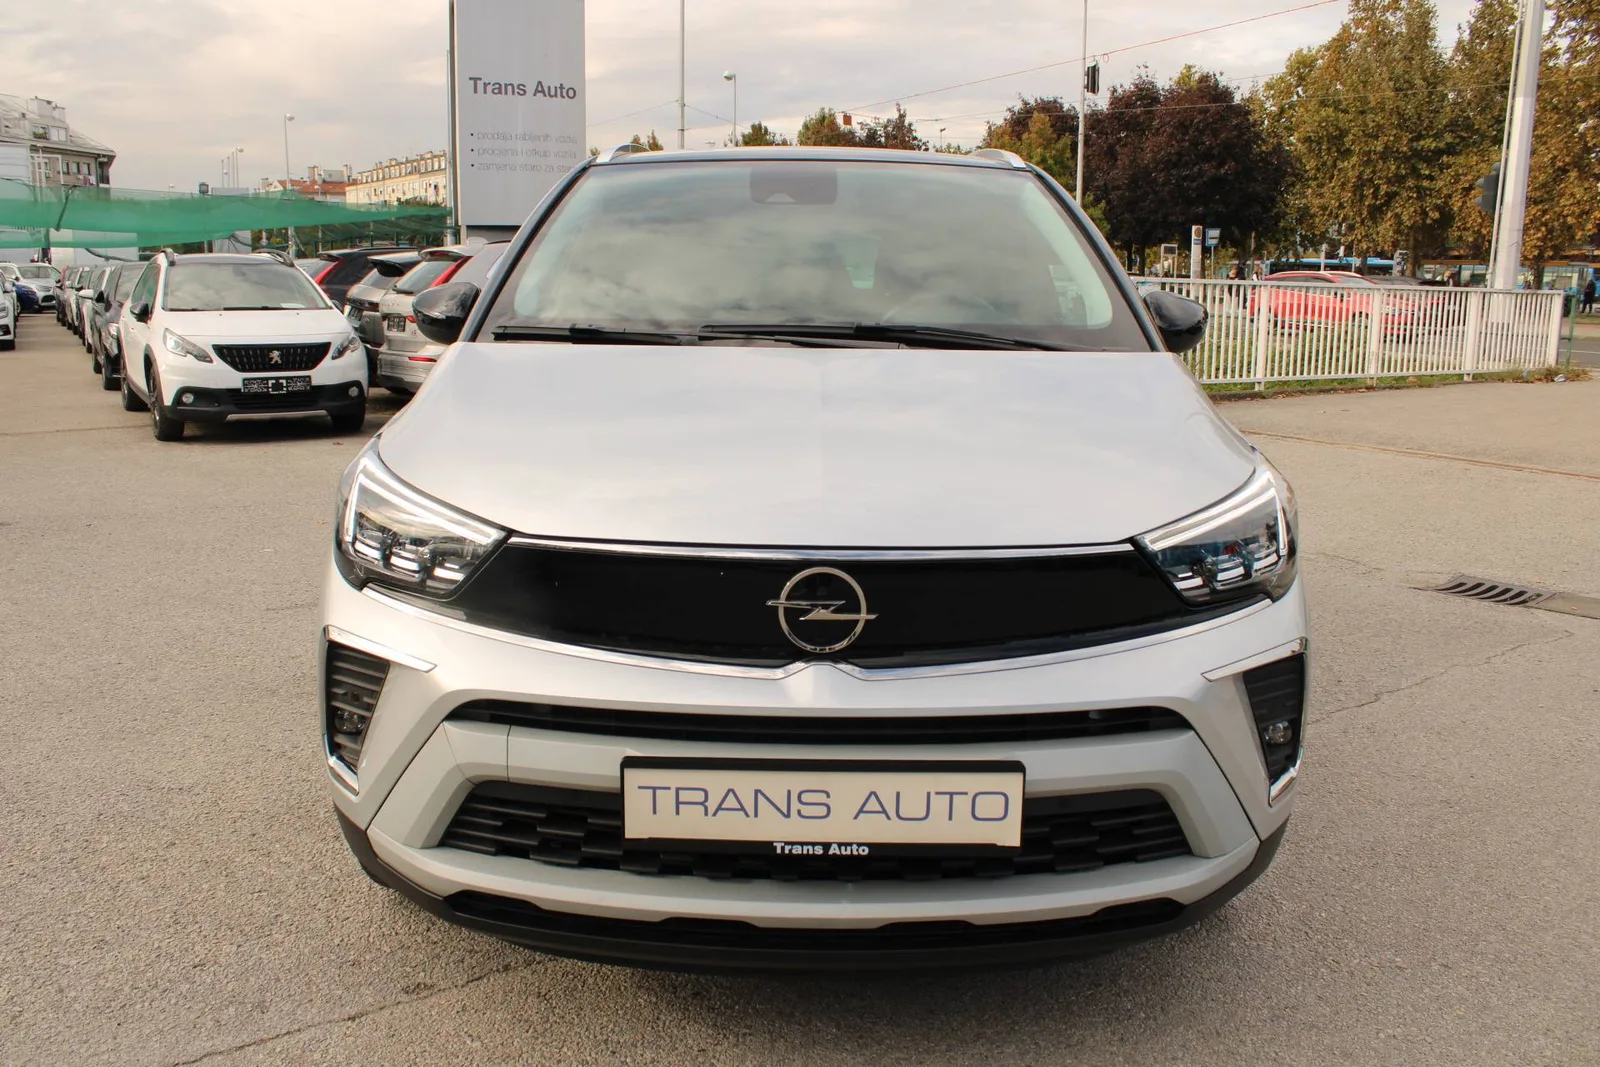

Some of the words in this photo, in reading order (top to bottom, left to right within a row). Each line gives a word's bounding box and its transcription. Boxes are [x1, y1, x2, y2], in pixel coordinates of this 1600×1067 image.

[469, 77, 527, 96] Trans
[533, 80, 577, 99] Auto
[637, 785, 831, 819] TRANS
[852, 790, 1009, 821] AUTO
[773, 842, 823, 855] Trans
[828, 843, 869, 855] Auto
